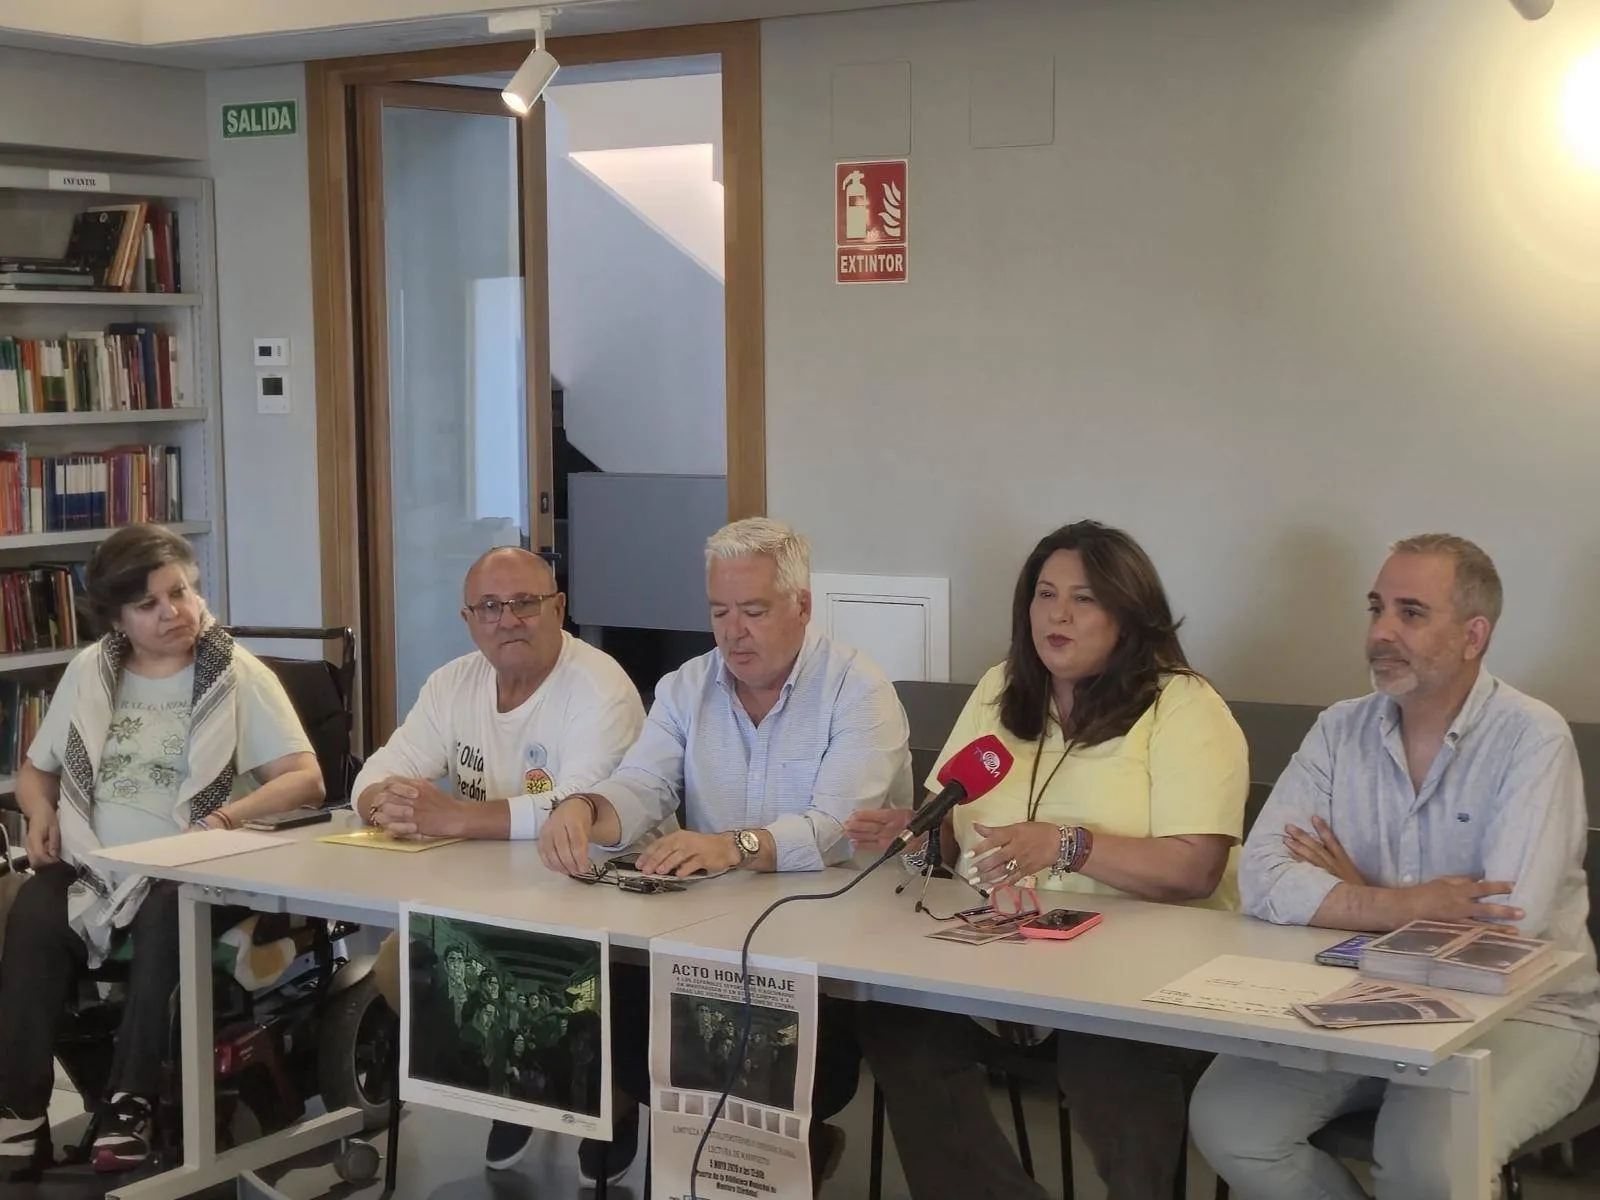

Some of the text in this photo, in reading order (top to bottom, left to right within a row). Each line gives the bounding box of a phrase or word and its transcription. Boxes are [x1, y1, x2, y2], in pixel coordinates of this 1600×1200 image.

[226, 105, 293, 133] SALIDA
[63, 177, 97, 186] INFANTIL
[840, 254, 904, 273] EXTINTOR
[672, 963, 709, 979] ACTO
[714, 969, 796, 992] HOMENAJE
